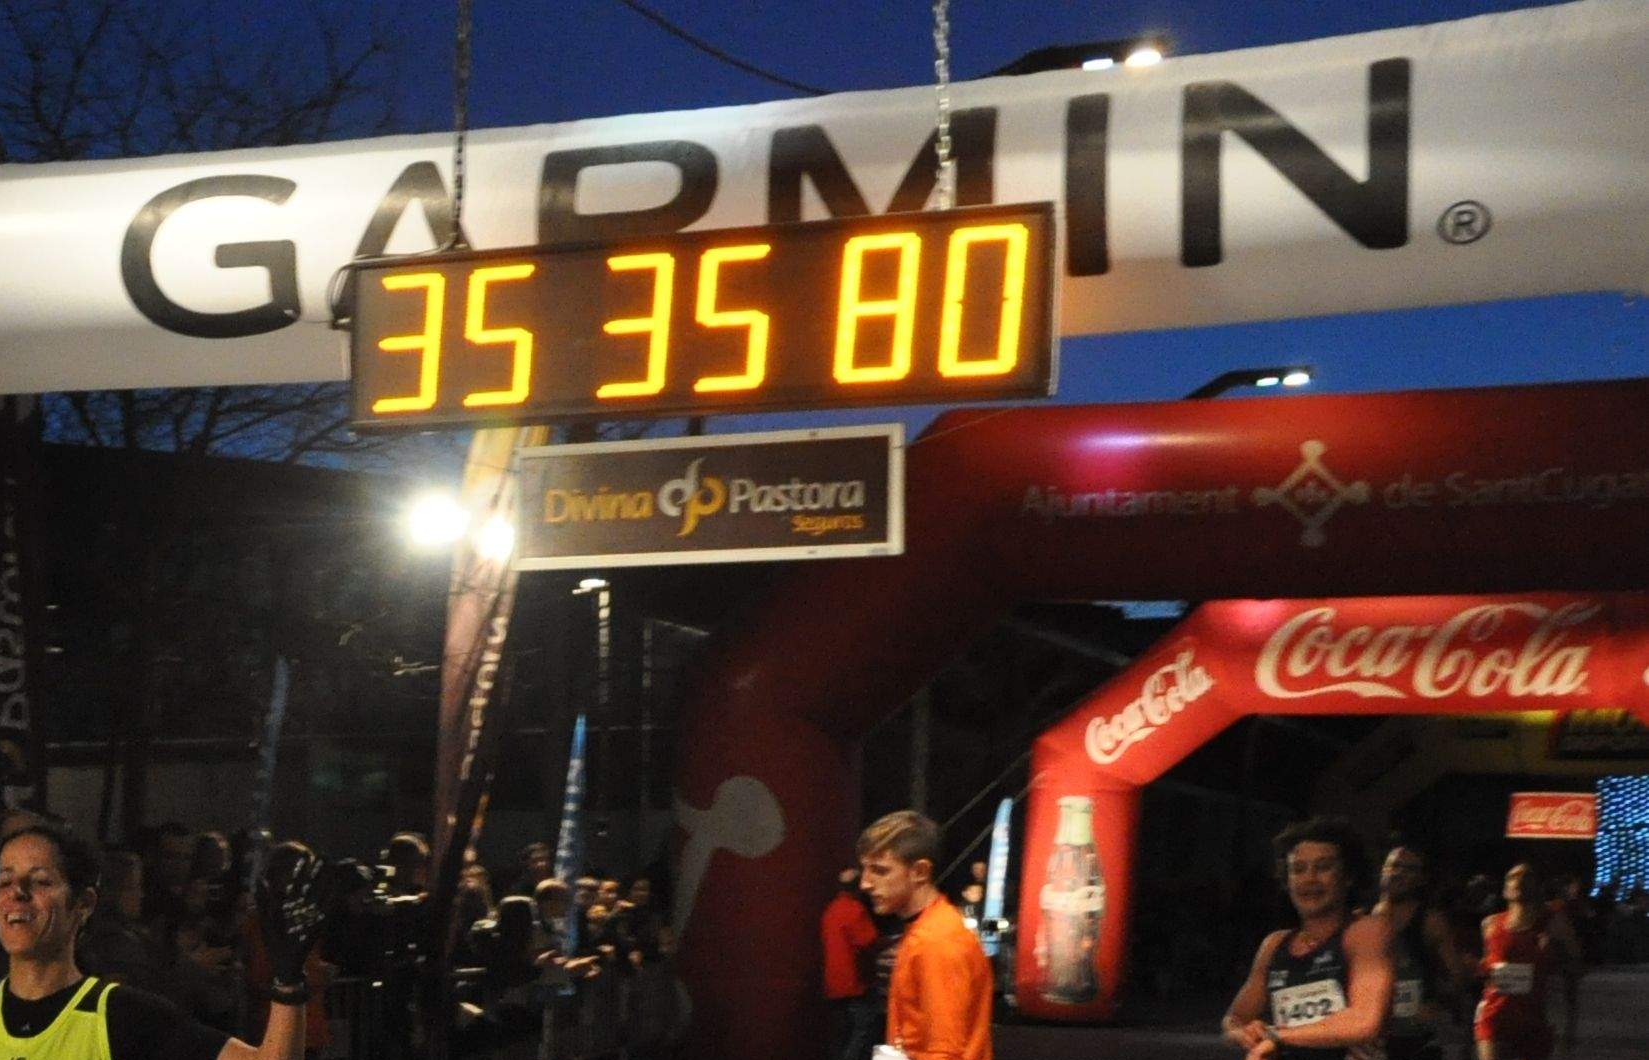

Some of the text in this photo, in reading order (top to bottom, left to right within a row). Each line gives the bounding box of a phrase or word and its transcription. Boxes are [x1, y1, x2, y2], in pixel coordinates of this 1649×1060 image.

[120, 57, 1412, 338] GARMIN
[372, 223, 1030, 413] 35 35 80
[543, 487, 654, 523] Divina
[728, 477, 866, 514] Pastora
[1022, 481, 1240, 521] Ajuntament
[1382, 472, 1437, 509] de
[1534, 465, 1649, 510] Cuga
[1255, 602, 1602, 699] Coca-Cola
[1084, 636, 1216, 765] Coca-Cola
[1276, 997, 1335, 1023] 1402
